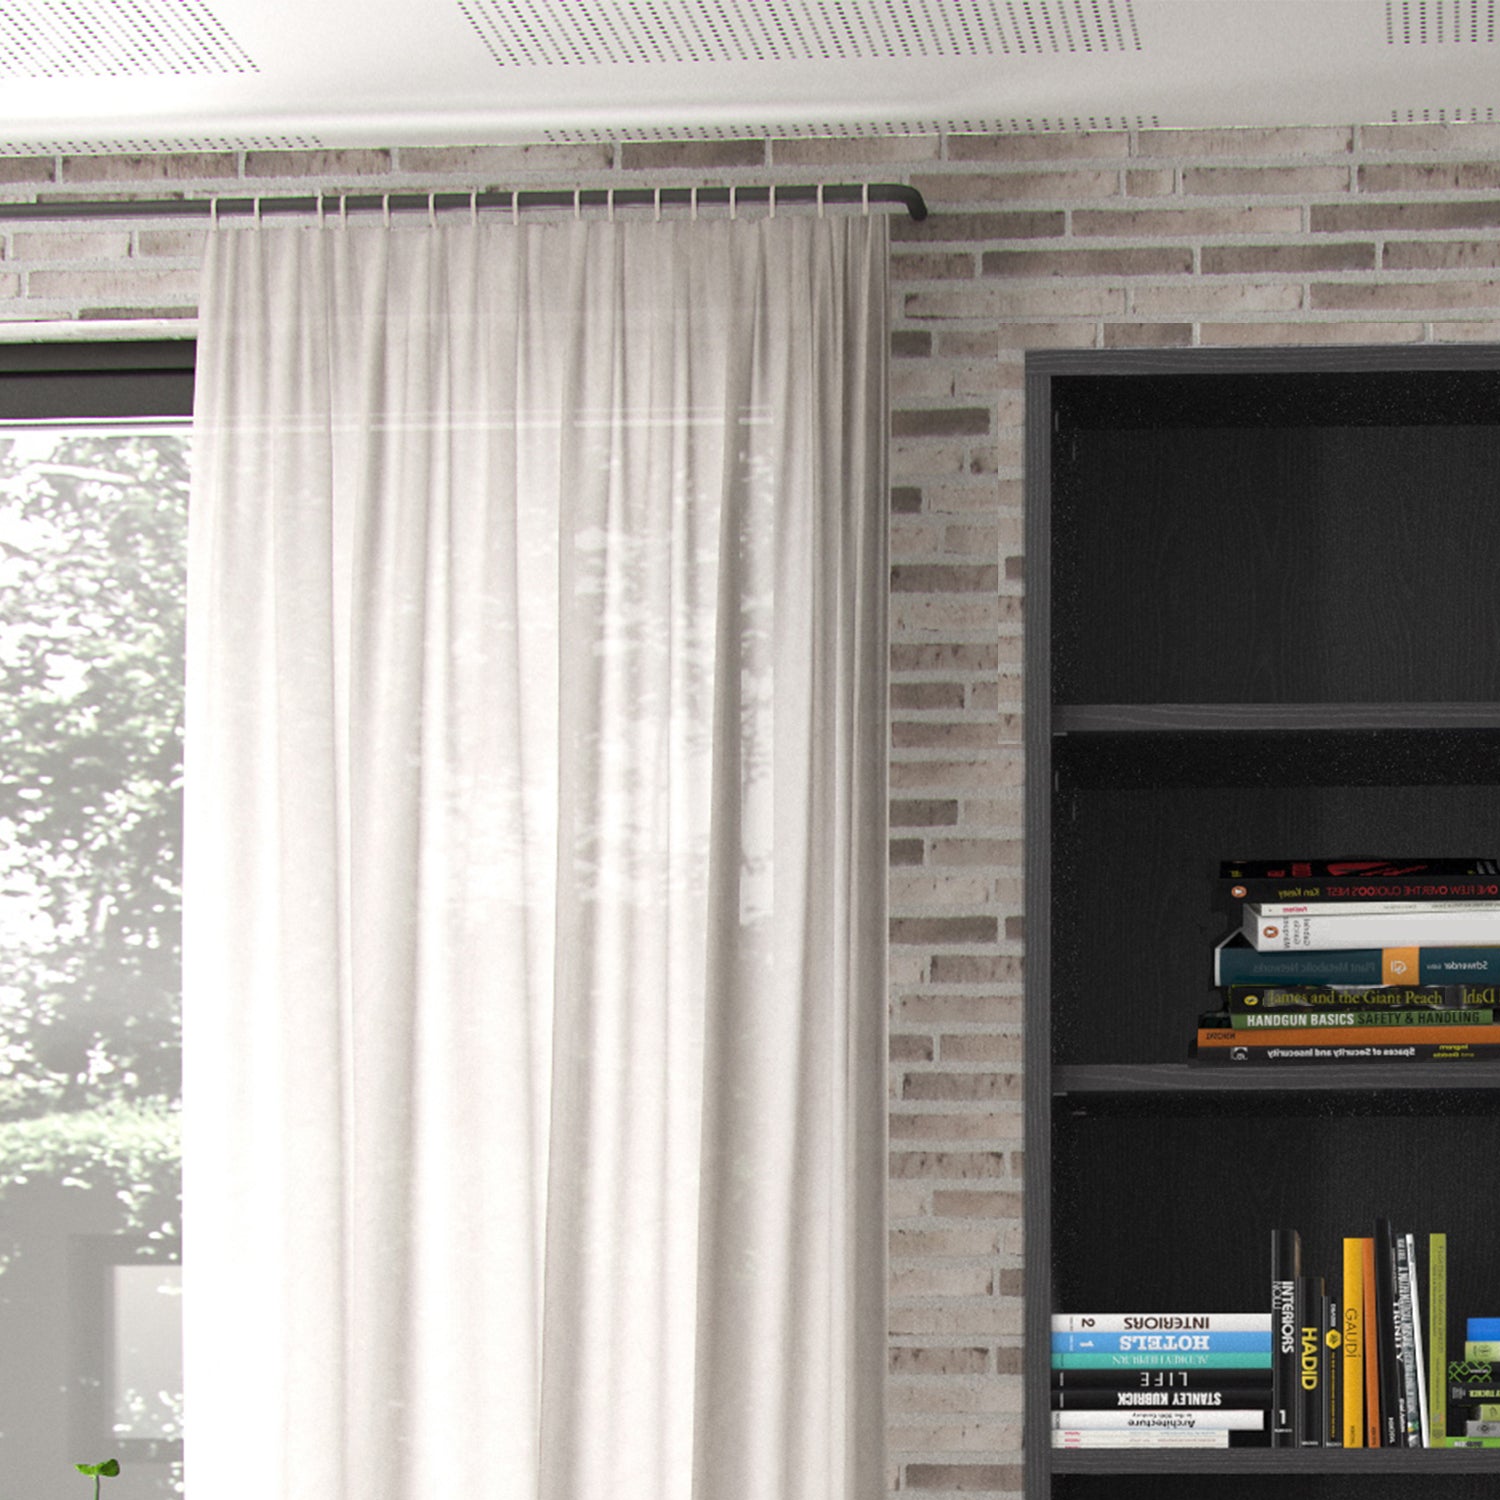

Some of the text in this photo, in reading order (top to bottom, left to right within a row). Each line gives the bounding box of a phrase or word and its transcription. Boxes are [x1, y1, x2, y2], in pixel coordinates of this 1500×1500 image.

[1313, 990, 1337, 1005] and
[1338, 990, 1361, 1005] the
[1363, 990, 1402, 1005] Giant
[1405, 990, 1443, 1006] Peach
[1246, 1011, 1480, 1028] HANDGUN BASICS SAFETY & HANDLING
[1272, 1280, 1282, 1310] NOW
[1081, 1317, 1210, 1330] INTERIORS 2
[1281, 1280, 1294, 1354] INTERIORS
[1344, 1307, 1361, 1359] GAUDÍ
[1392, 1300, 1404, 1363] TRINITY
[1119, 1335, 1210, 1351] HOTELS
[1301, 1327, 1318, 1390] HADID
[1139, 1371, 1188, 1387] LIFE
[1117, 1391, 1222, 1406] STANLEY KUBRICK
[1127, 1419, 1196, 1429] Architecture
